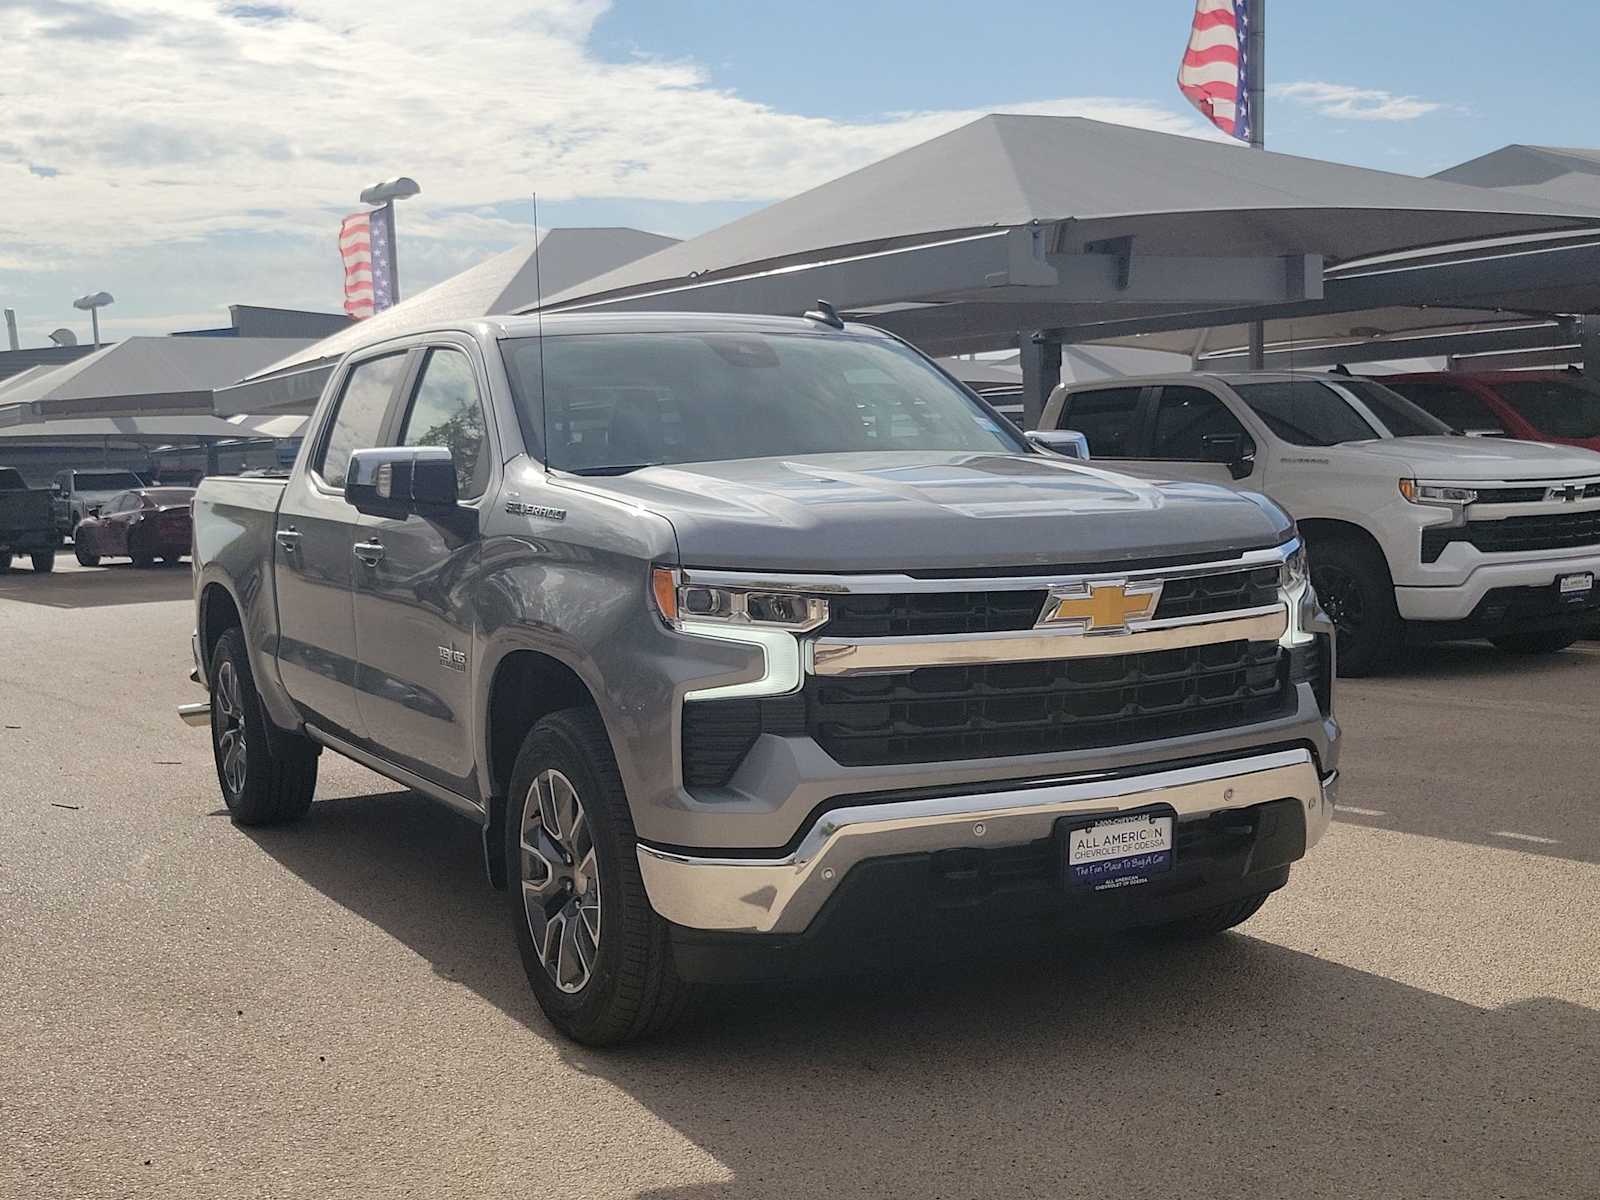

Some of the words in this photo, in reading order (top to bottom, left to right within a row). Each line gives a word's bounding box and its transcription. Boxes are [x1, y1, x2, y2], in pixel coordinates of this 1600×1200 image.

[1074, 845, 1121, 860] CHEVROLET
[1122, 843, 1134, 853] OF
[1135, 838, 1165, 851] ODESSA
[1077, 838, 1100, 850] ALL
[1103, 828, 1162, 846] AMERICN
[1122, 859, 1131, 870] To
[1145, 855, 1152, 865] A
